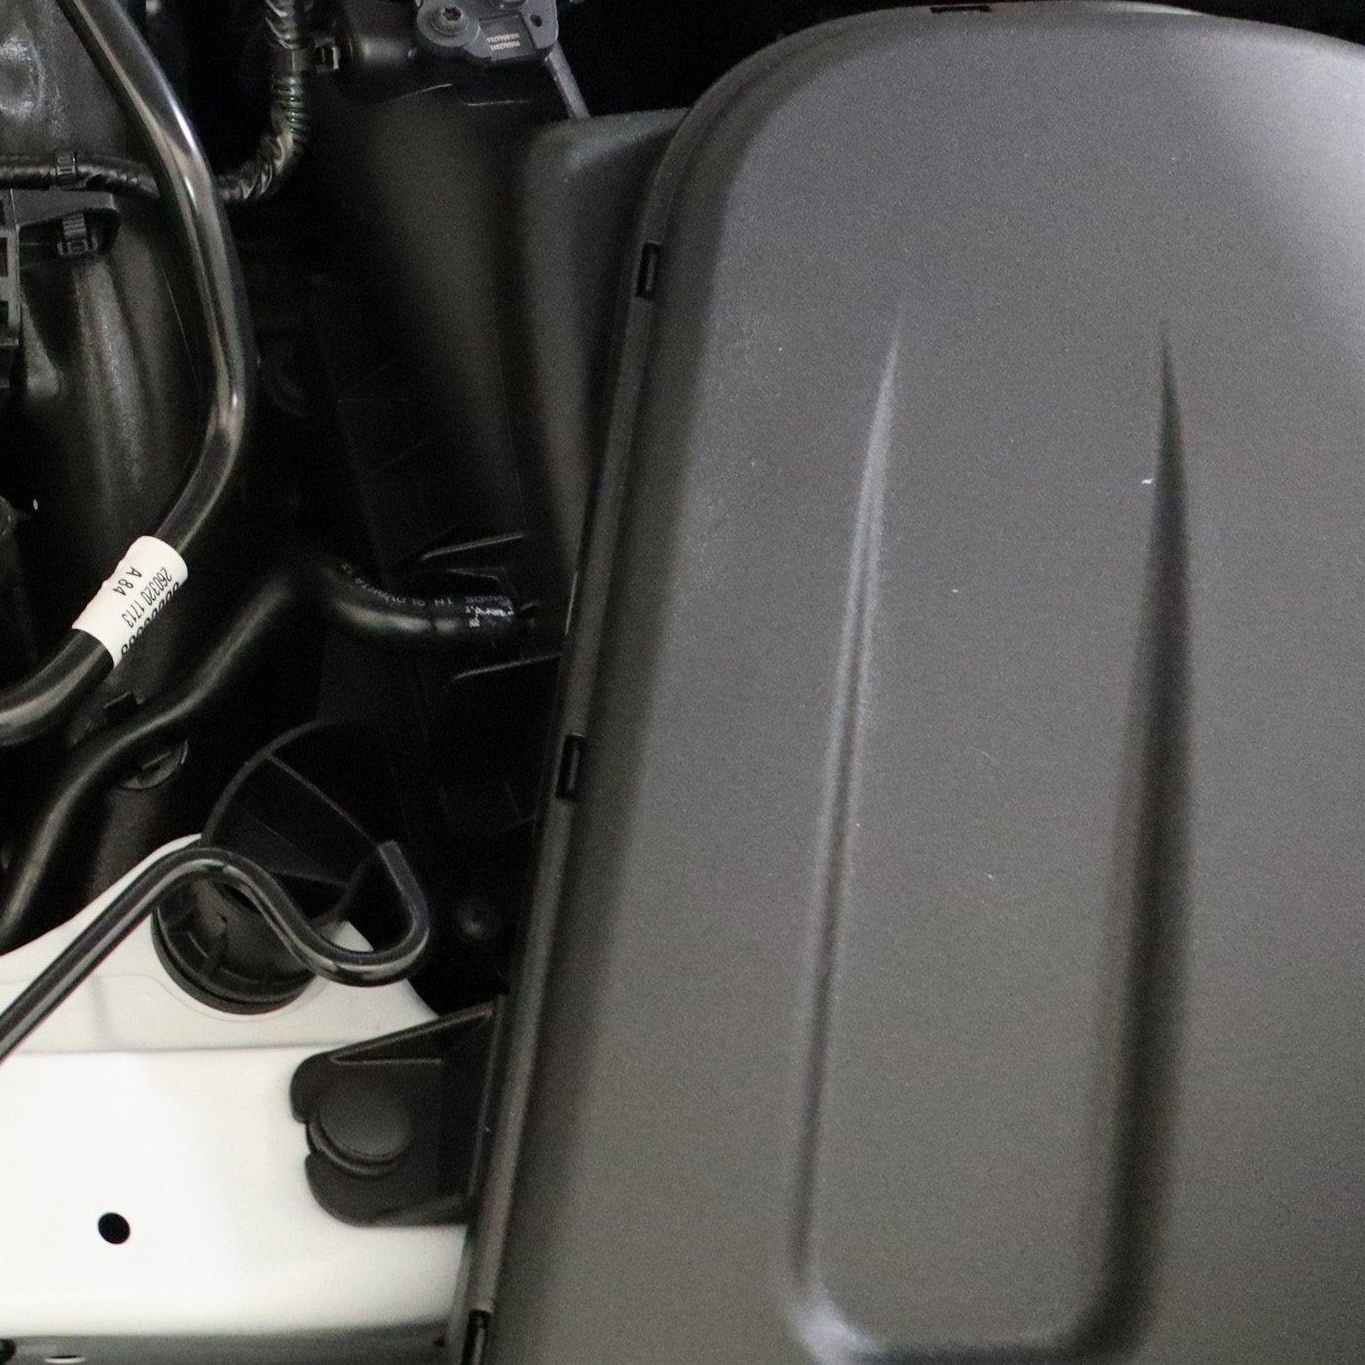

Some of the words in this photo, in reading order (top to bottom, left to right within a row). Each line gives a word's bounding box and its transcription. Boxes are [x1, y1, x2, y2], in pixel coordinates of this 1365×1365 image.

[126, 566, 143, 578] A
[112, 578, 135, 596] 84
[140, 566, 174, 606] 260320
[121, 600, 146, 628] 1713
